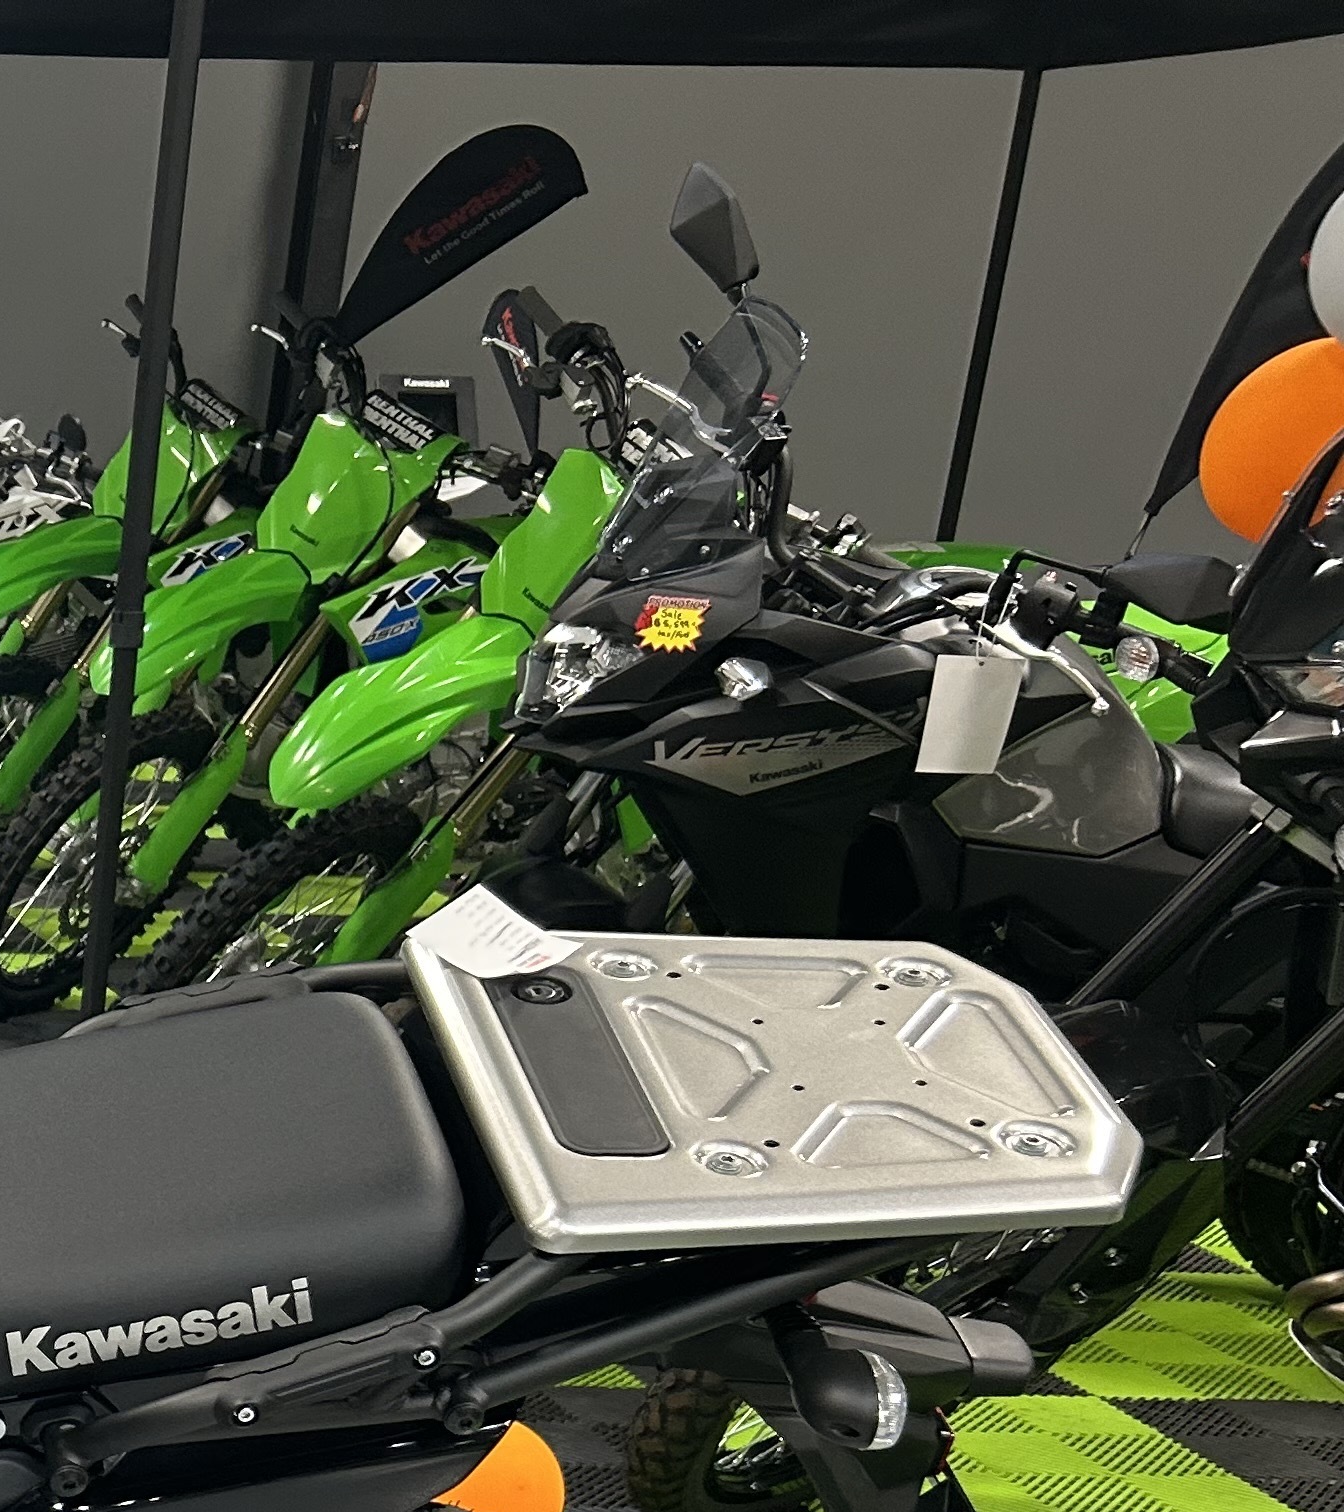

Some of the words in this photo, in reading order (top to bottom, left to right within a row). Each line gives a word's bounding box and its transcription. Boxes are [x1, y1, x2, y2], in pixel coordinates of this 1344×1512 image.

[406, 158, 541, 254] Kawasaki
[423, 249, 441, 265] Let
[442, 236, 460, 252] the
[462, 217, 490, 240] Good
[490, 198, 523, 221] Times
[521, 180, 545, 200] Roll
[404, 378, 450, 388] Kawasaki
[366, 394, 435, 440] RENTHAL
[356, 557, 477, 622] KX
[661, 608, 682, 620] Sale
[749, 759, 823, 784] Kawasaki
[5, 1277, 315, 1377] Kawasaki
